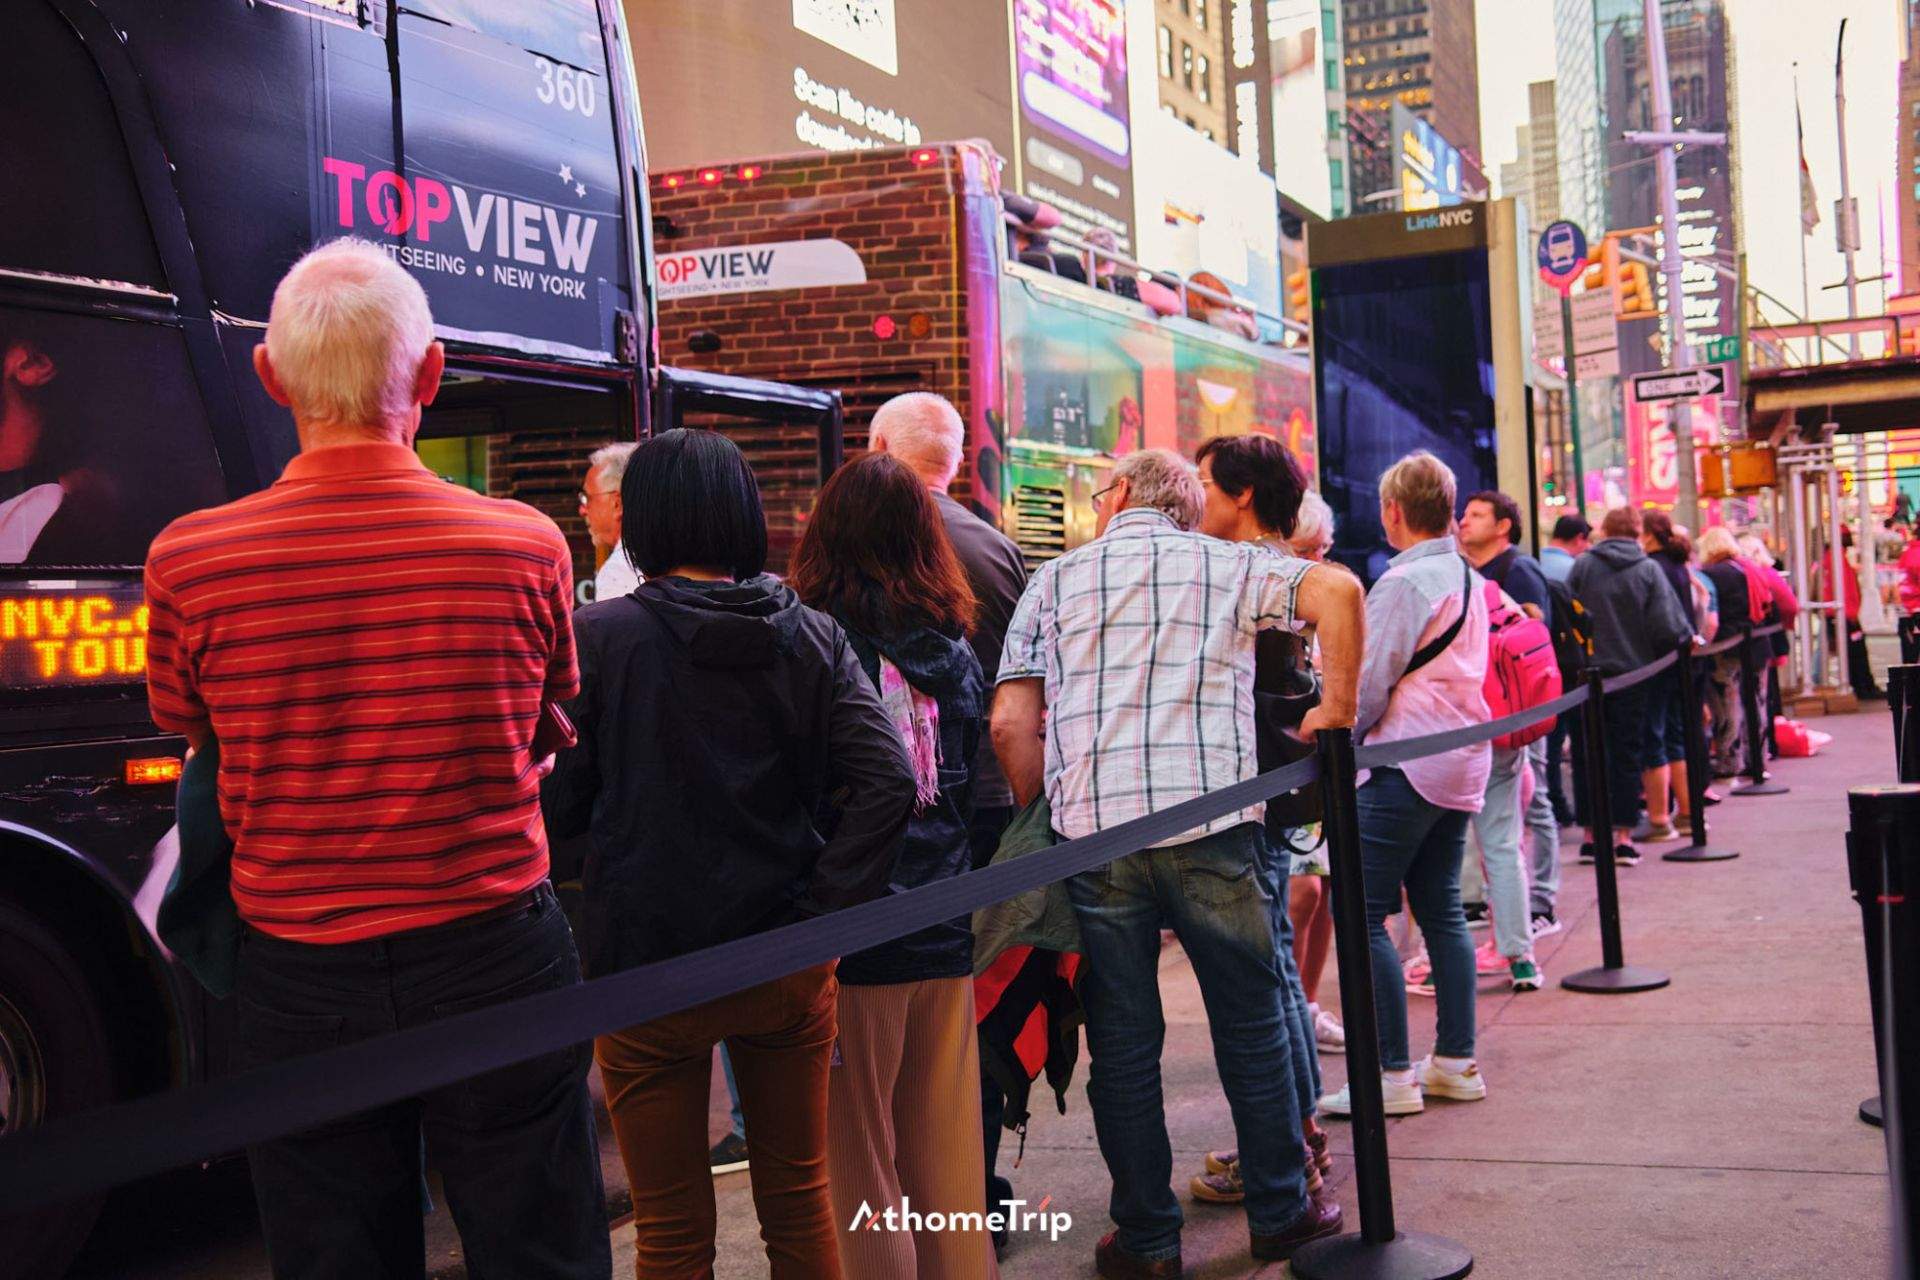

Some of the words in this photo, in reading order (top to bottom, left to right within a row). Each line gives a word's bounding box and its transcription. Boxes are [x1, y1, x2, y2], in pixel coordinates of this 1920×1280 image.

[535, 57, 595, 117] 360
[793, 65, 839, 115] Scan
[323, 157, 598, 273] TOPVIEW
[1406, 209, 1473, 232] LinkNYC
[339, 236, 467, 276] TSEEING
[493, 264, 535, 290] NEW
[539, 273, 586, 300] YORK
[656, 250, 775, 284] OPVIEW
[1645, 381, 1671, 396] ONE
